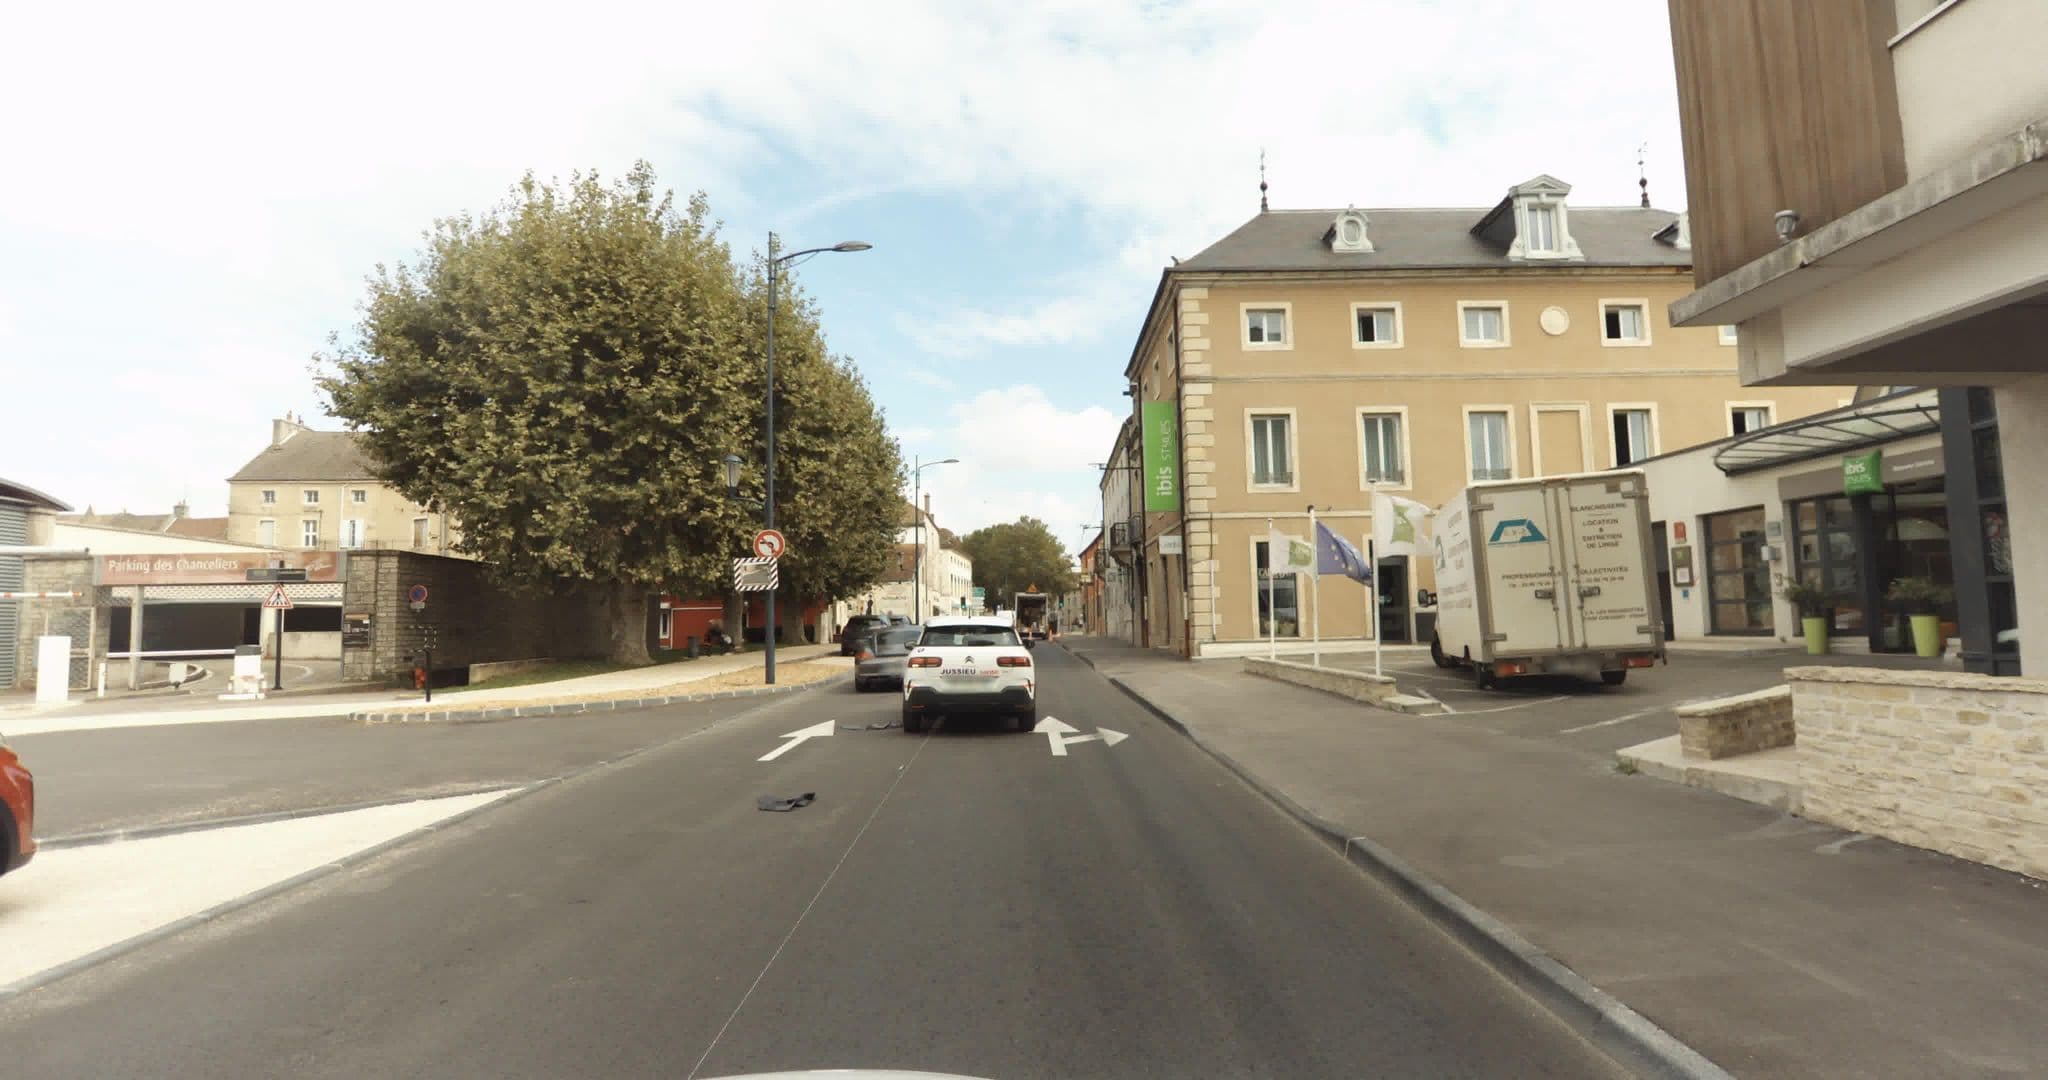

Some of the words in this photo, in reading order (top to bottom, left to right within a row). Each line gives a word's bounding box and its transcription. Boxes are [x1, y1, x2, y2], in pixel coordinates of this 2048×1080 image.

[1156, 466, 1173, 496] ibis
[1582, 518, 1619, 527] LOCATION
[108, 559, 149, 573] Parking
[153, 559, 173, 571] des
[176, 558, 239, 571] Chanceliers
